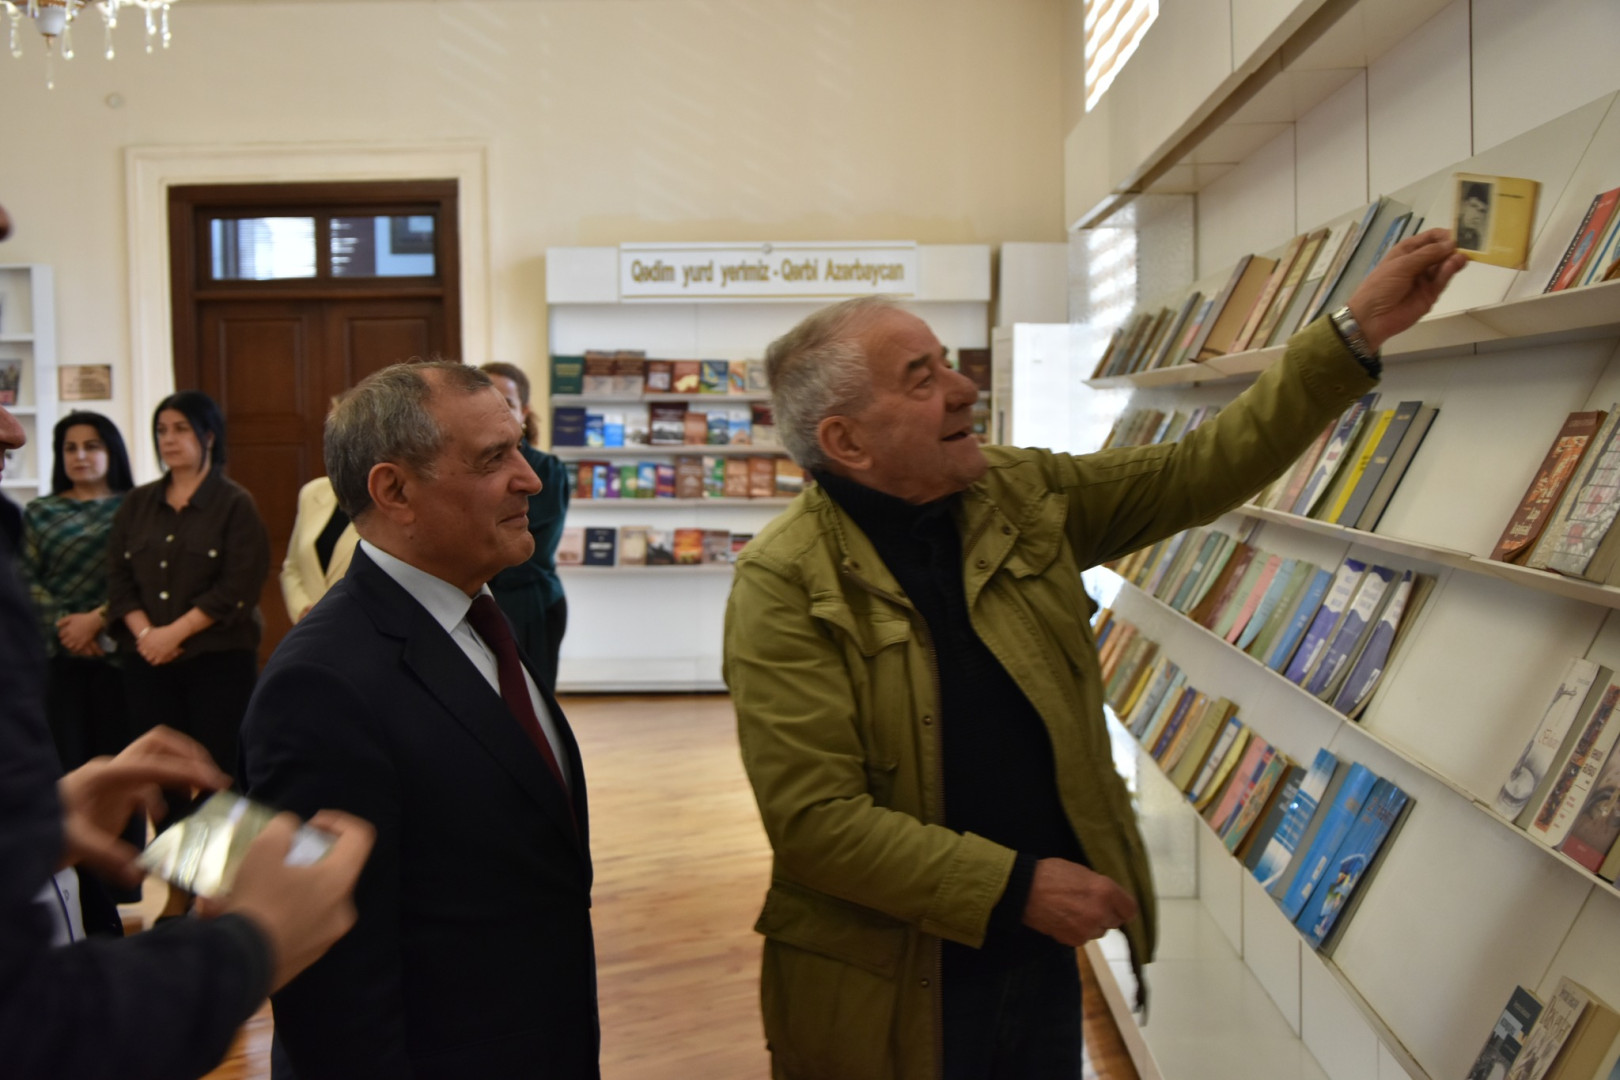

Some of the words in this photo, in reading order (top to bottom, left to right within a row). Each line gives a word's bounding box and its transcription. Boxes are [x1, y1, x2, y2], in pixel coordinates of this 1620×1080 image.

[631, 259, 675, 282] Qədim
[682, 259, 714, 287] yurd
[721, 259, 770, 287] yerimiz
[781, 257, 818, 281] Qərbi
[824, 257, 905, 286] Azərbaycan
